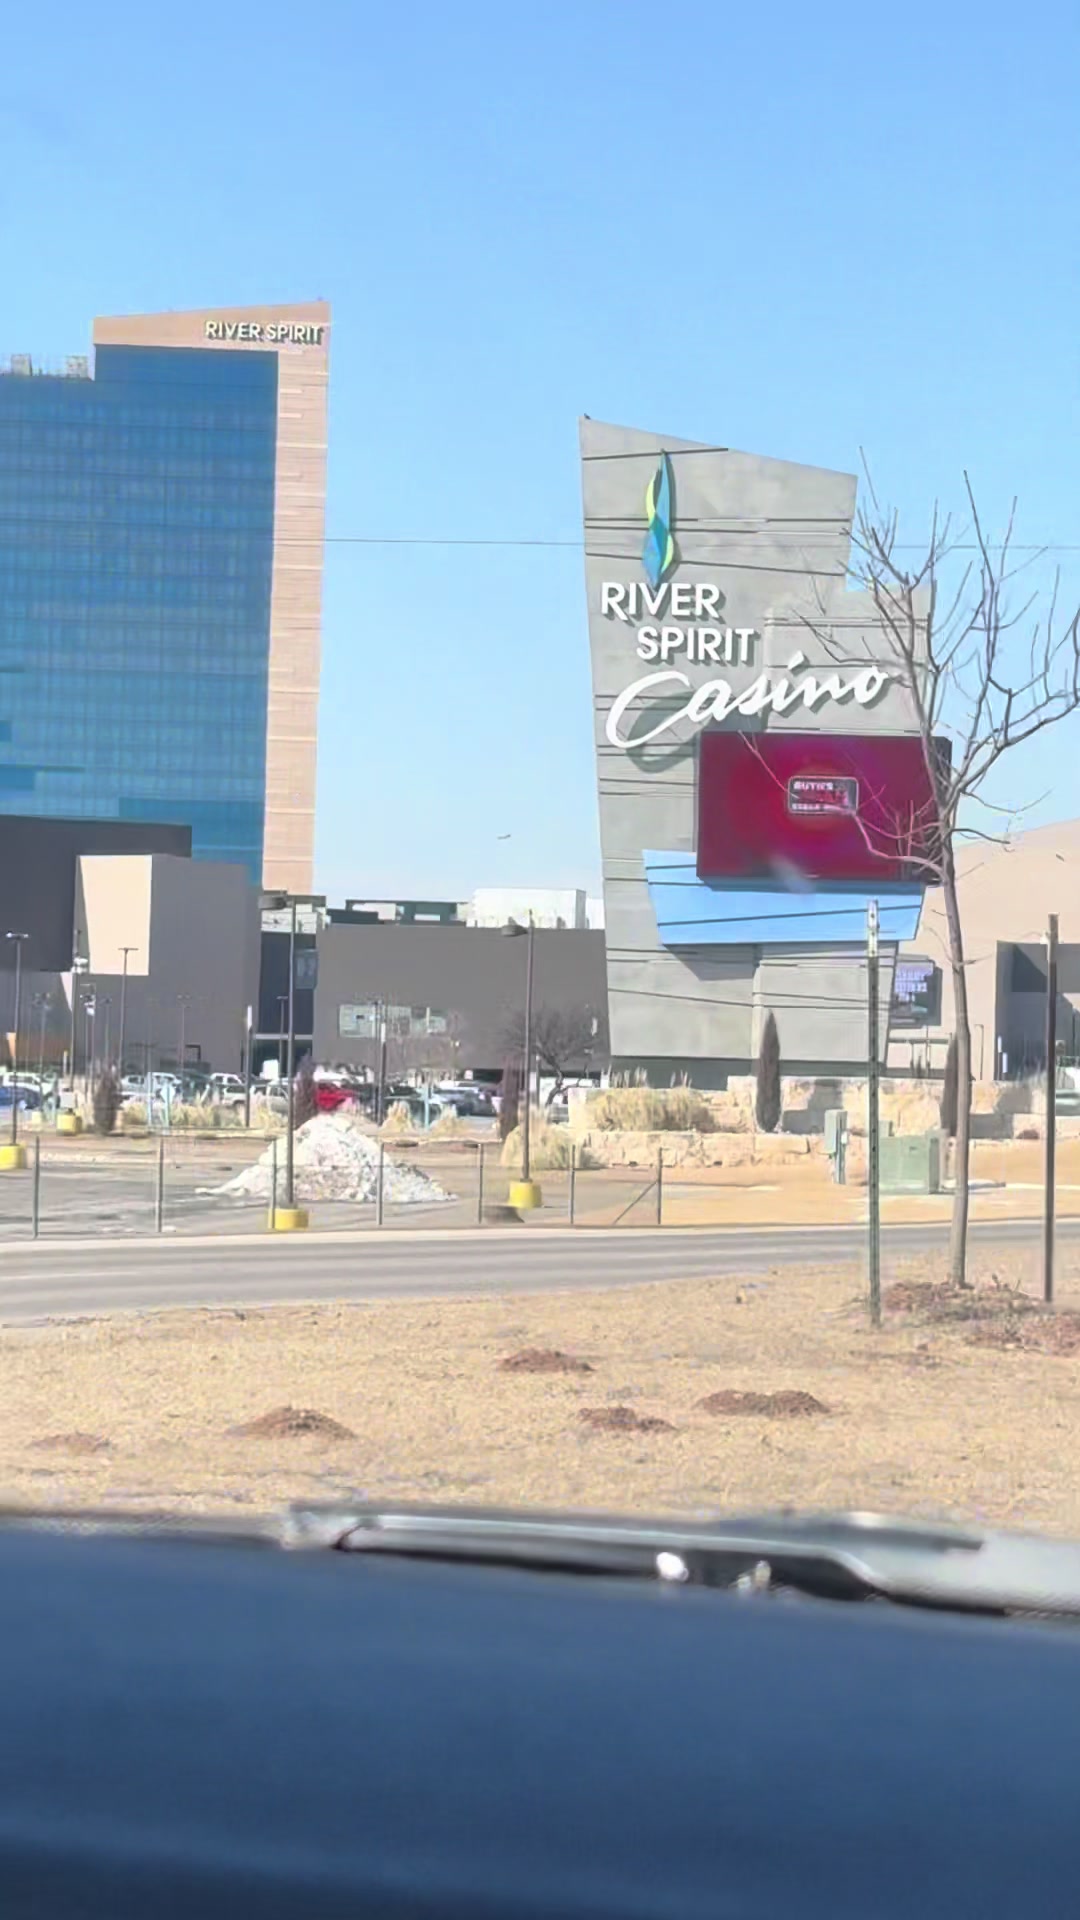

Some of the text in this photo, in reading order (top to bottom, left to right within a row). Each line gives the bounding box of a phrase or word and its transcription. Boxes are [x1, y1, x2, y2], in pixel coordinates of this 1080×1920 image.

[205, 320, 323, 344] RIVER SPIRIT
[601, 582, 722, 621] RIVER
[637, 626, 757, 663] SPIRIT
[605, 650, 889, 749] Casino
